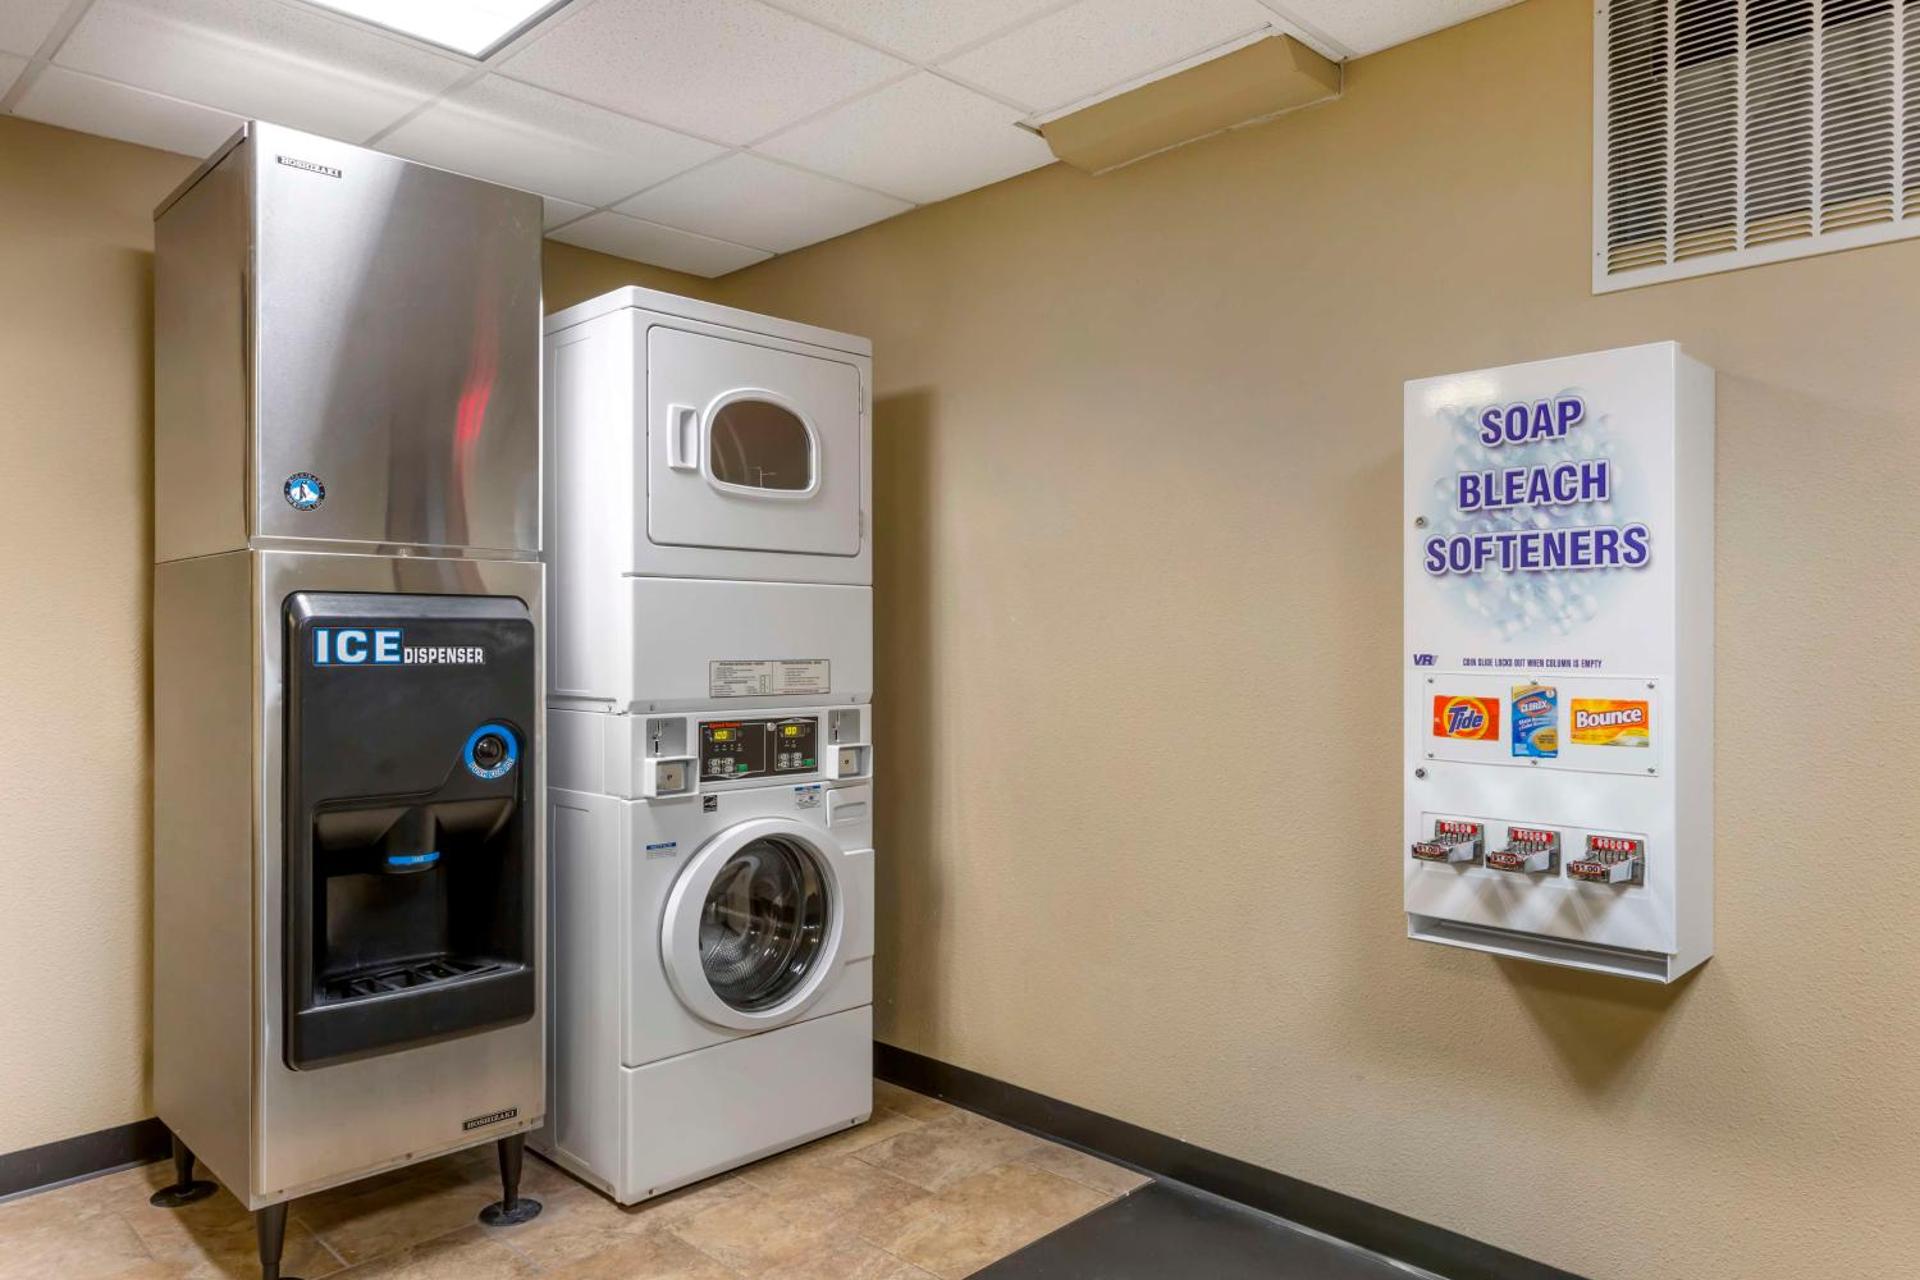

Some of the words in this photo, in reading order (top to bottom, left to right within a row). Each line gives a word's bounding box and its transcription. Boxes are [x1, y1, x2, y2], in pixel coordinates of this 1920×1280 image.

[1480, 399, 1583, 445] SOAP
[1459, 461, 1608, 509] BLEACH
[1425, 527, 1648, 573] SOFTENERS
[316, 629, 401, 664] ICE
[403, 647, 484, 664] DISPENSER
[1462, 657, 1477, 667] COIN
[1478, 657, 1494, 667] SLIDE
[1495, 658, 1513, 668] LOCKS
[1514, 658, 1526, 668] OUT
[1527, 658, 1545, 668] WHEN
[1546, 658, 1572, 668] COLUMN
[1573, 659, 1580, 668] IS
[1581, 659, 1602, 669] EMPTY
[1448, 705, 1484, 733] Tide
[1576, 709, 1642, 728] Bounce
[1574, 863, 1599, 873] $1.00
